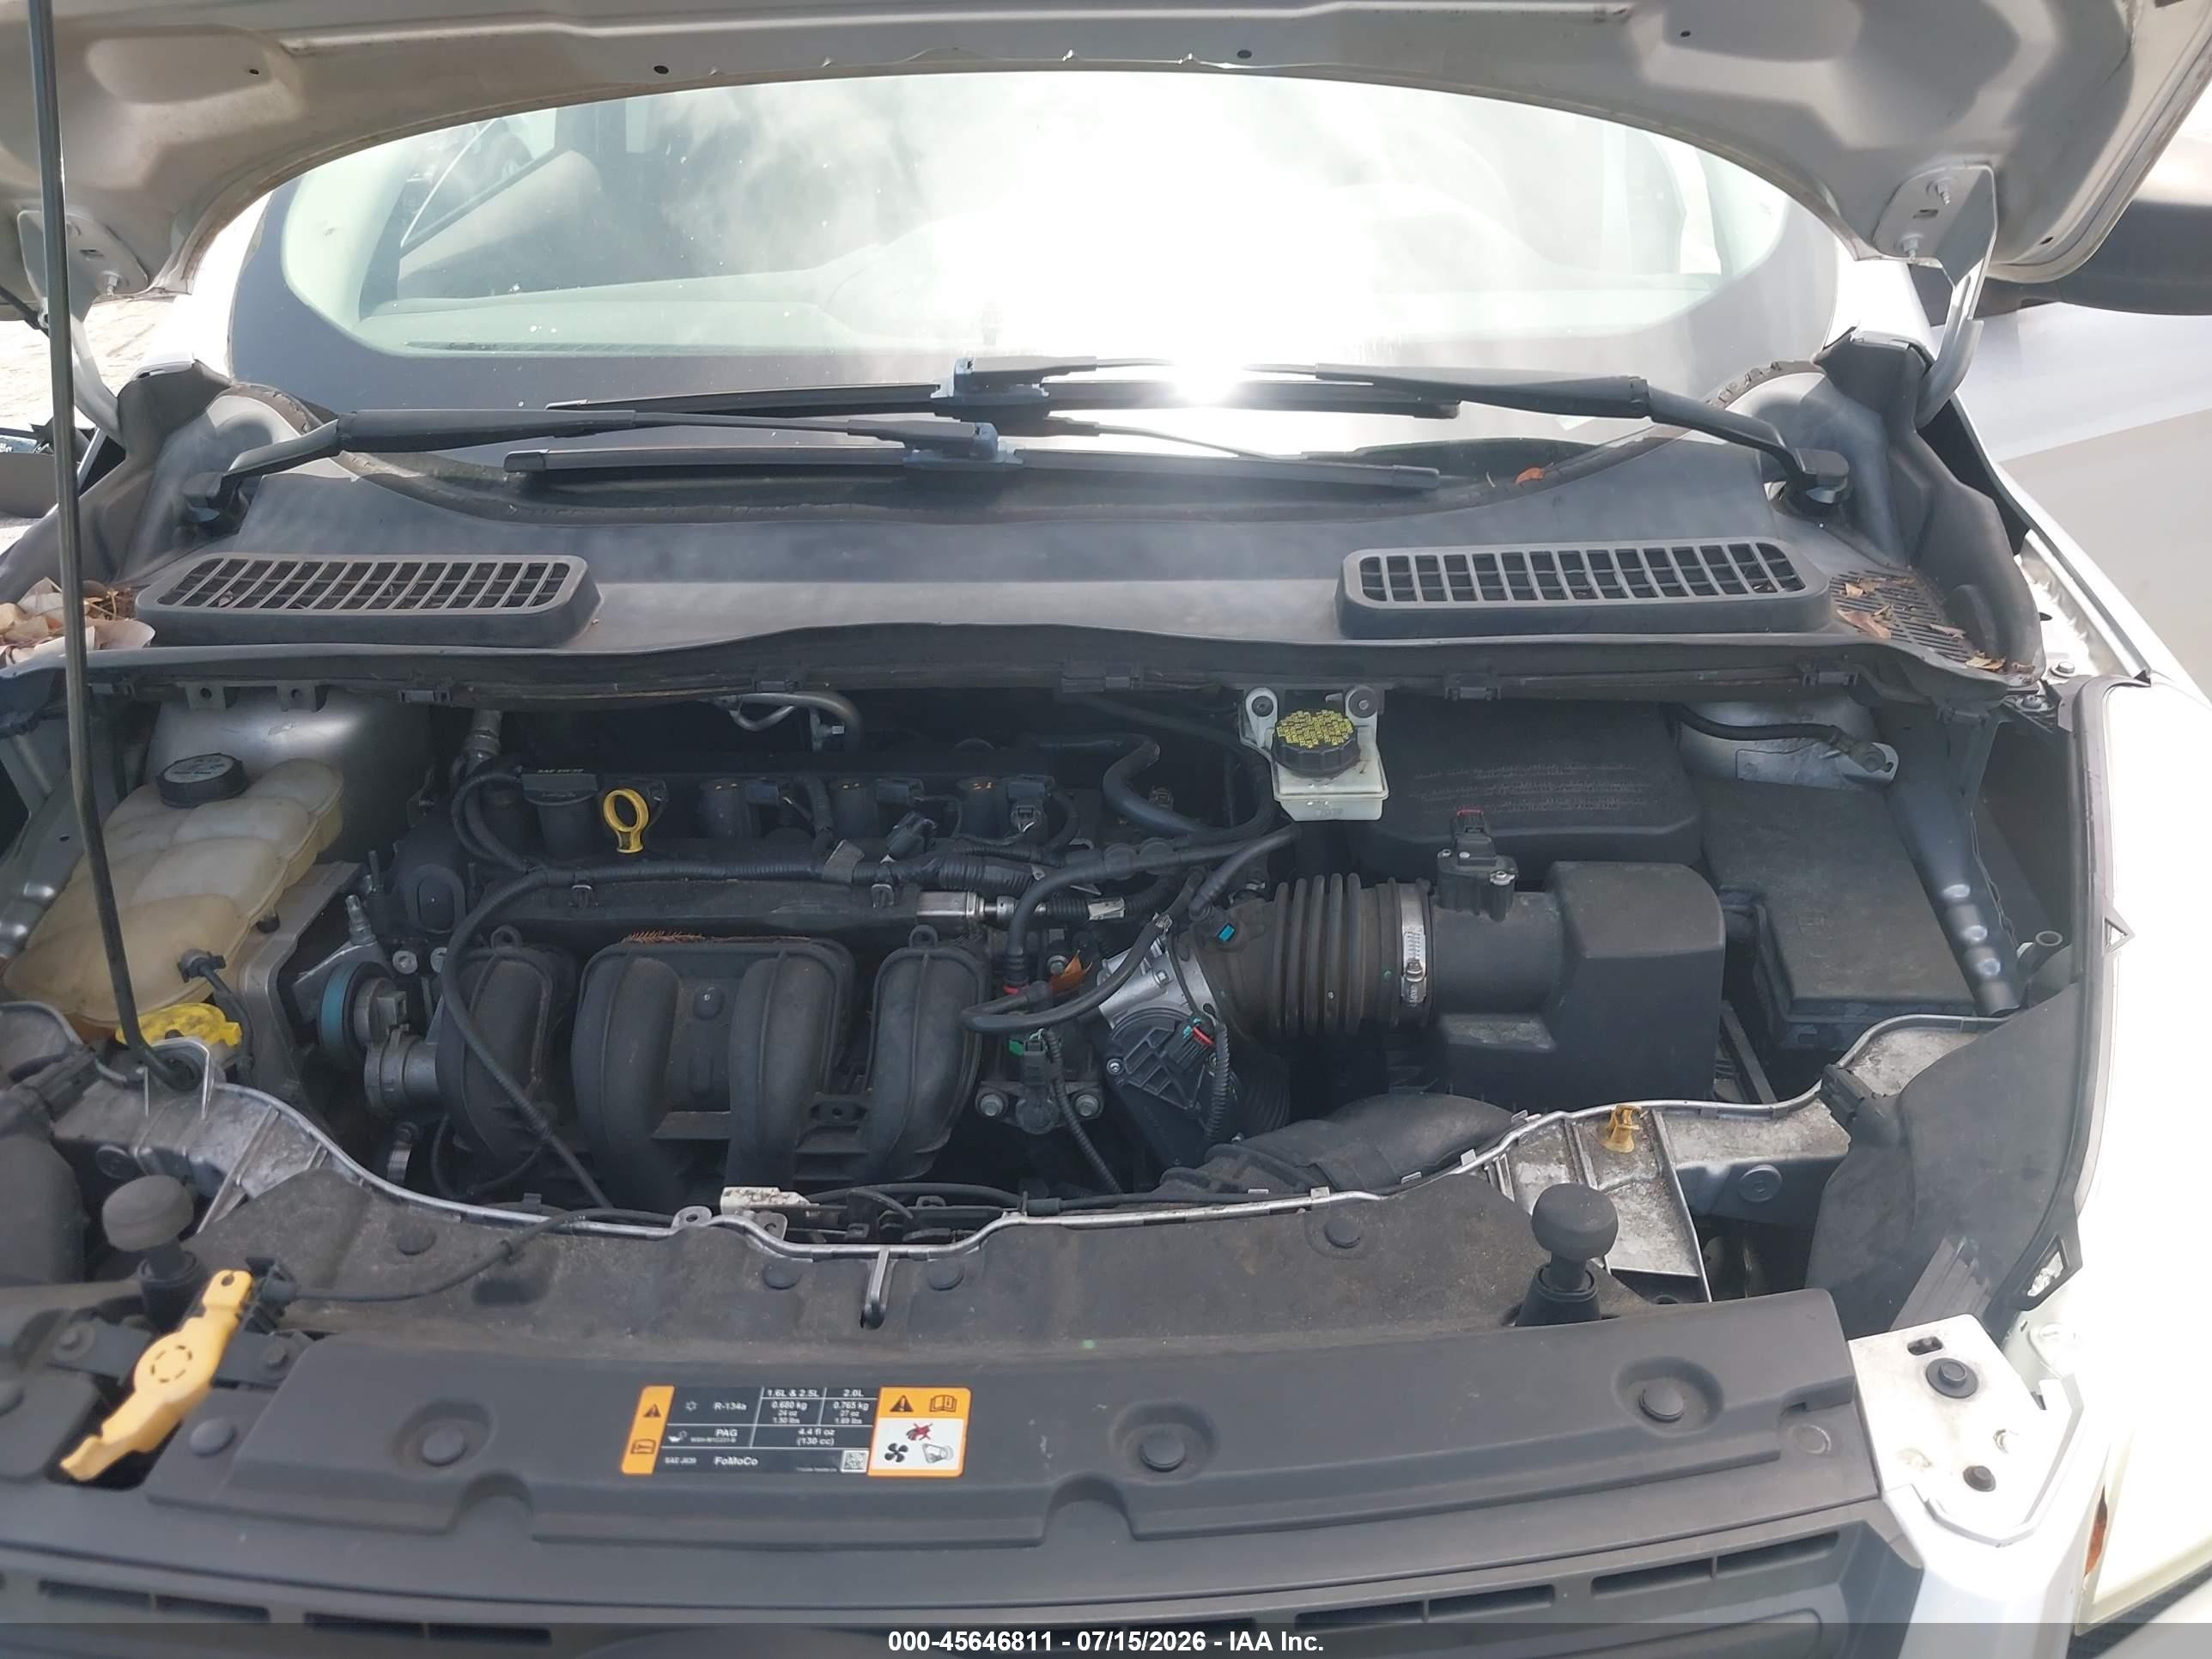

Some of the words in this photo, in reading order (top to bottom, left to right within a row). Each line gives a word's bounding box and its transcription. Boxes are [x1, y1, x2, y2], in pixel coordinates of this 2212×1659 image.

[714, 1401, 747, 1411] R-134a
[796, 1401, 808, 1411] kg
[858, 1401, 869, 1412] kg
[797, 1437, 817, 1446] (130
[819, 1437, 835, 1446] cc)
[714, 1456, 759, 1466] FoMoCo
